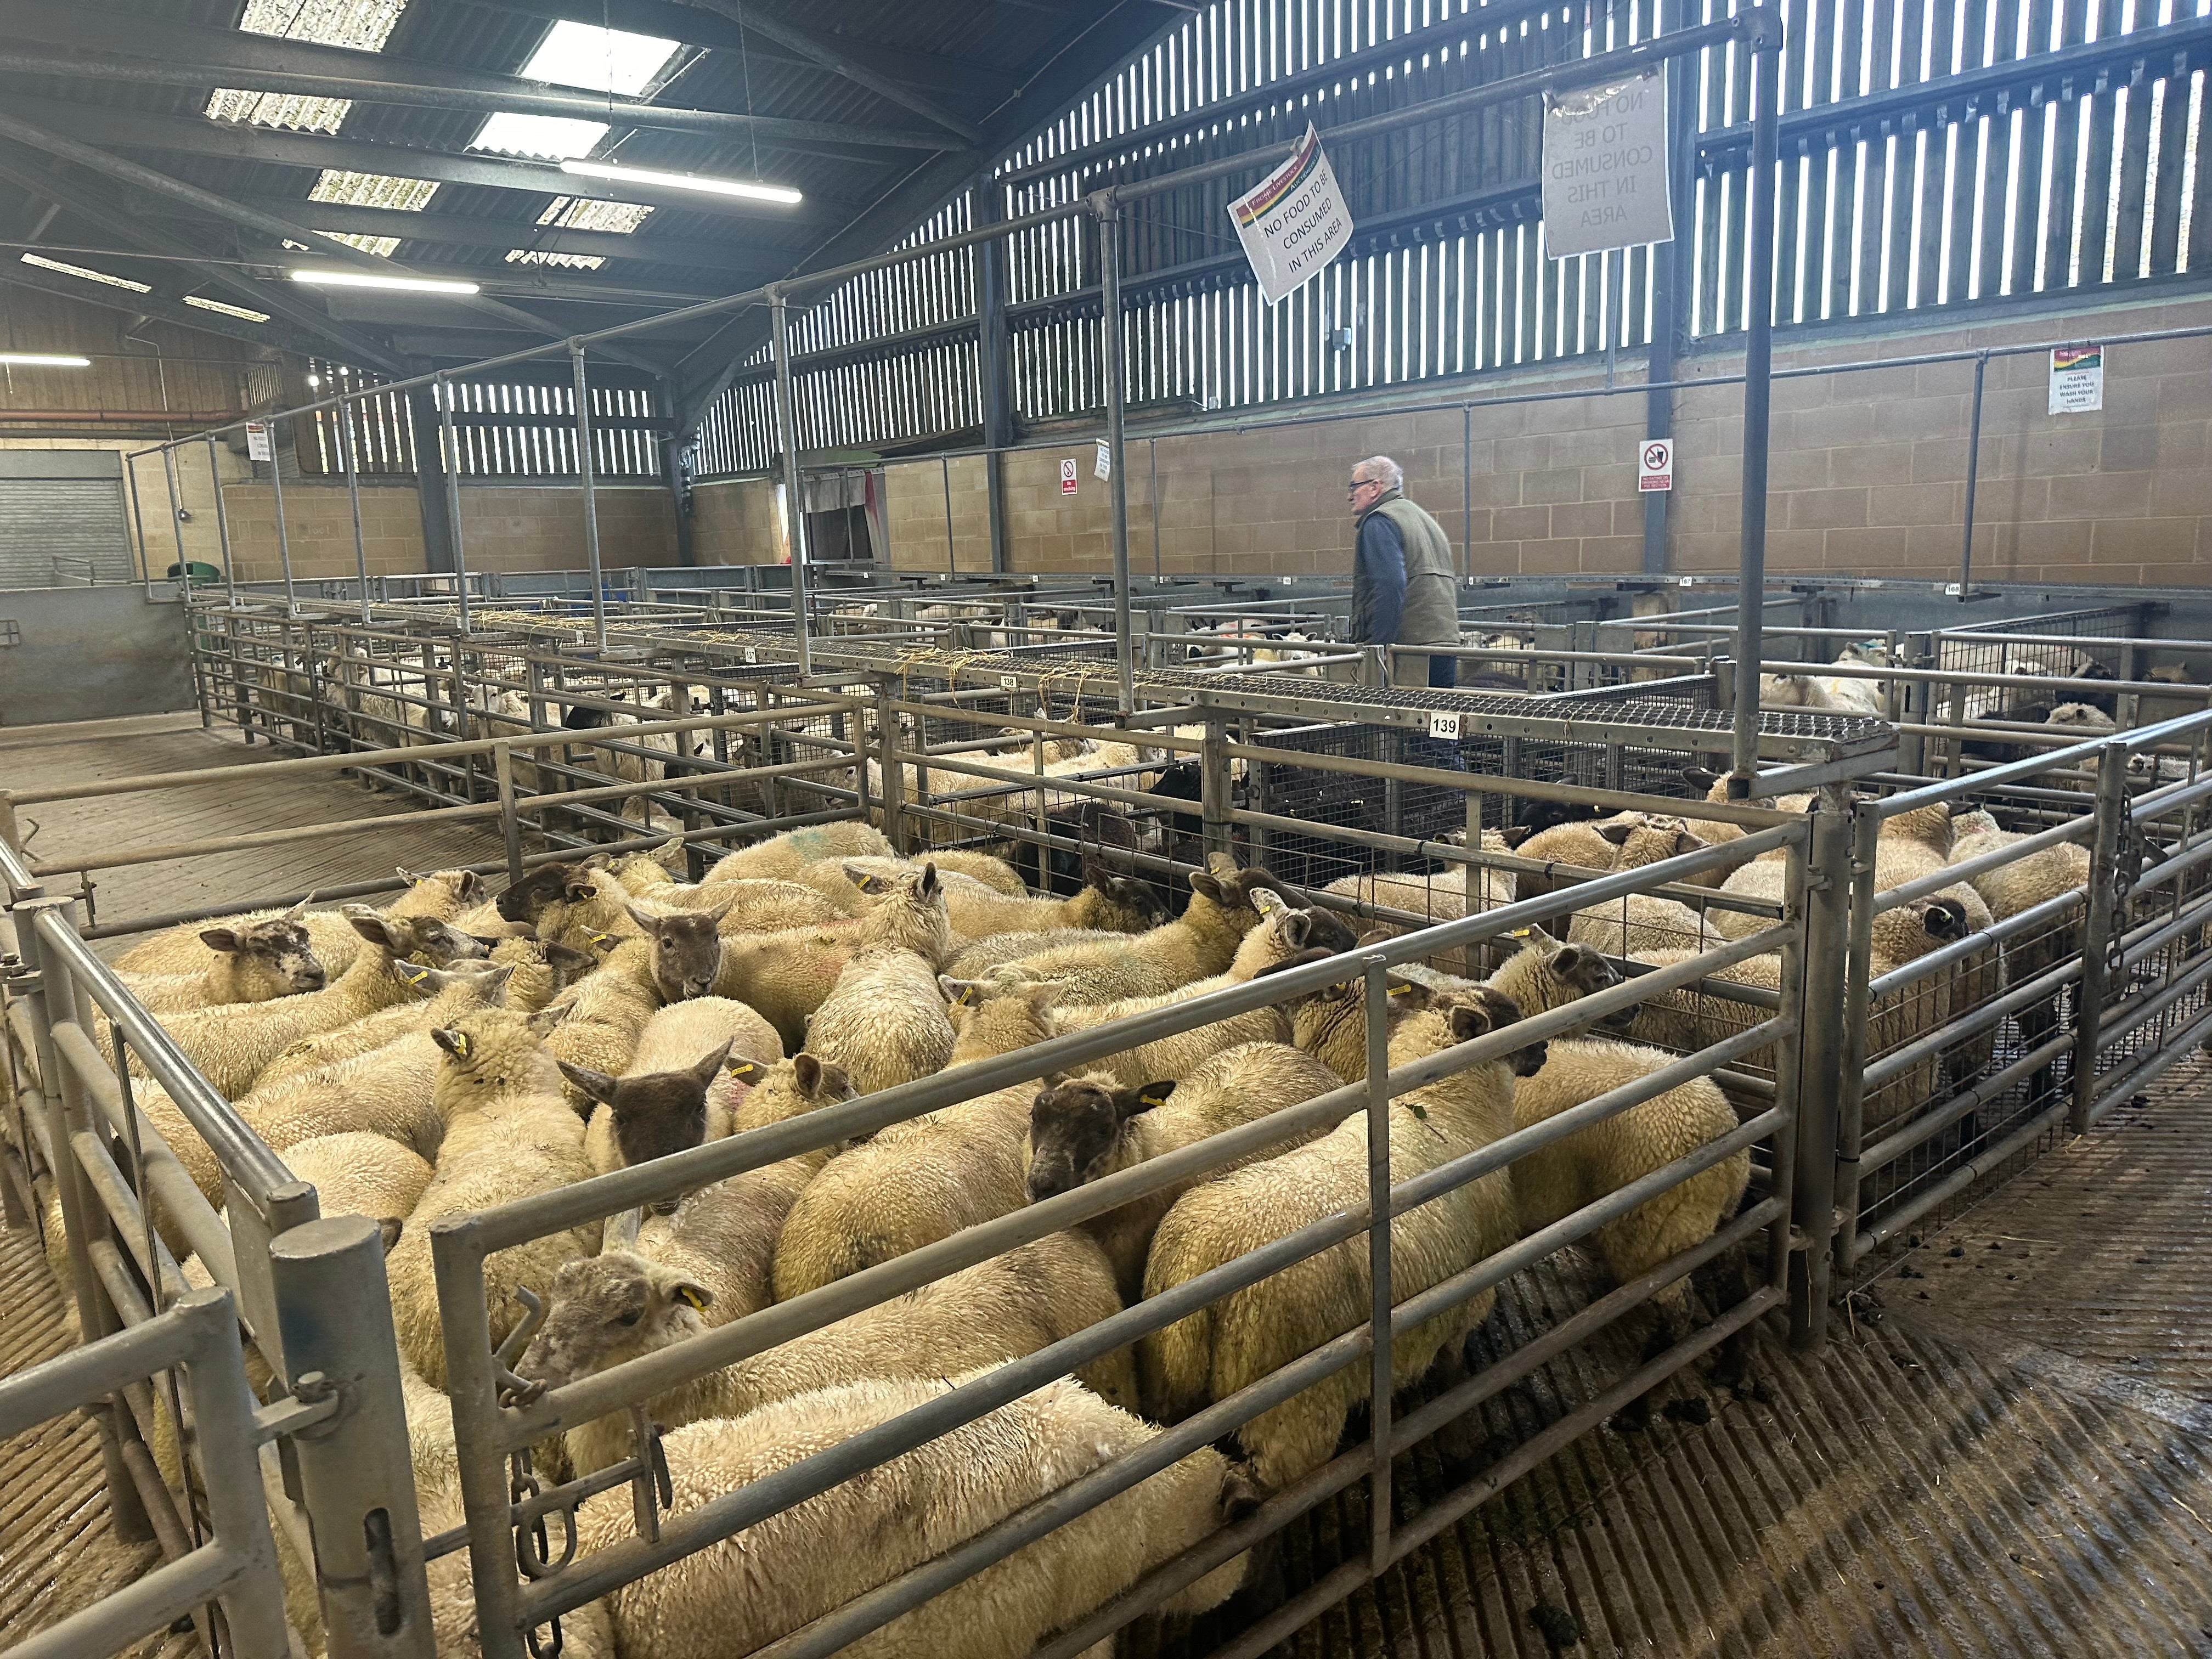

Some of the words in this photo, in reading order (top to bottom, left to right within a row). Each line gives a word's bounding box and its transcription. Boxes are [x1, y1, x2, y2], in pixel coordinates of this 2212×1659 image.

[1272, 165, 1299, 190] LIVESTOCK
[1264, 219, 1282, 238] NO
[1283, 194, 1310, 224] FOOD
[1310, 181, 1321, 199] TO
[1319, 168, 1328, 186] BE
[1283, 197, 1332, 250] CONSUMED
[1288, 259, 1301, 273] IN
[1301, 238, 1324, 263] THIS
[1324, 217, 1342, 245] AREA
[746, 651, 754, 659] 137
[1003, 678, 1014, 686] 138
[1434, 718, 1456, 733] 139
